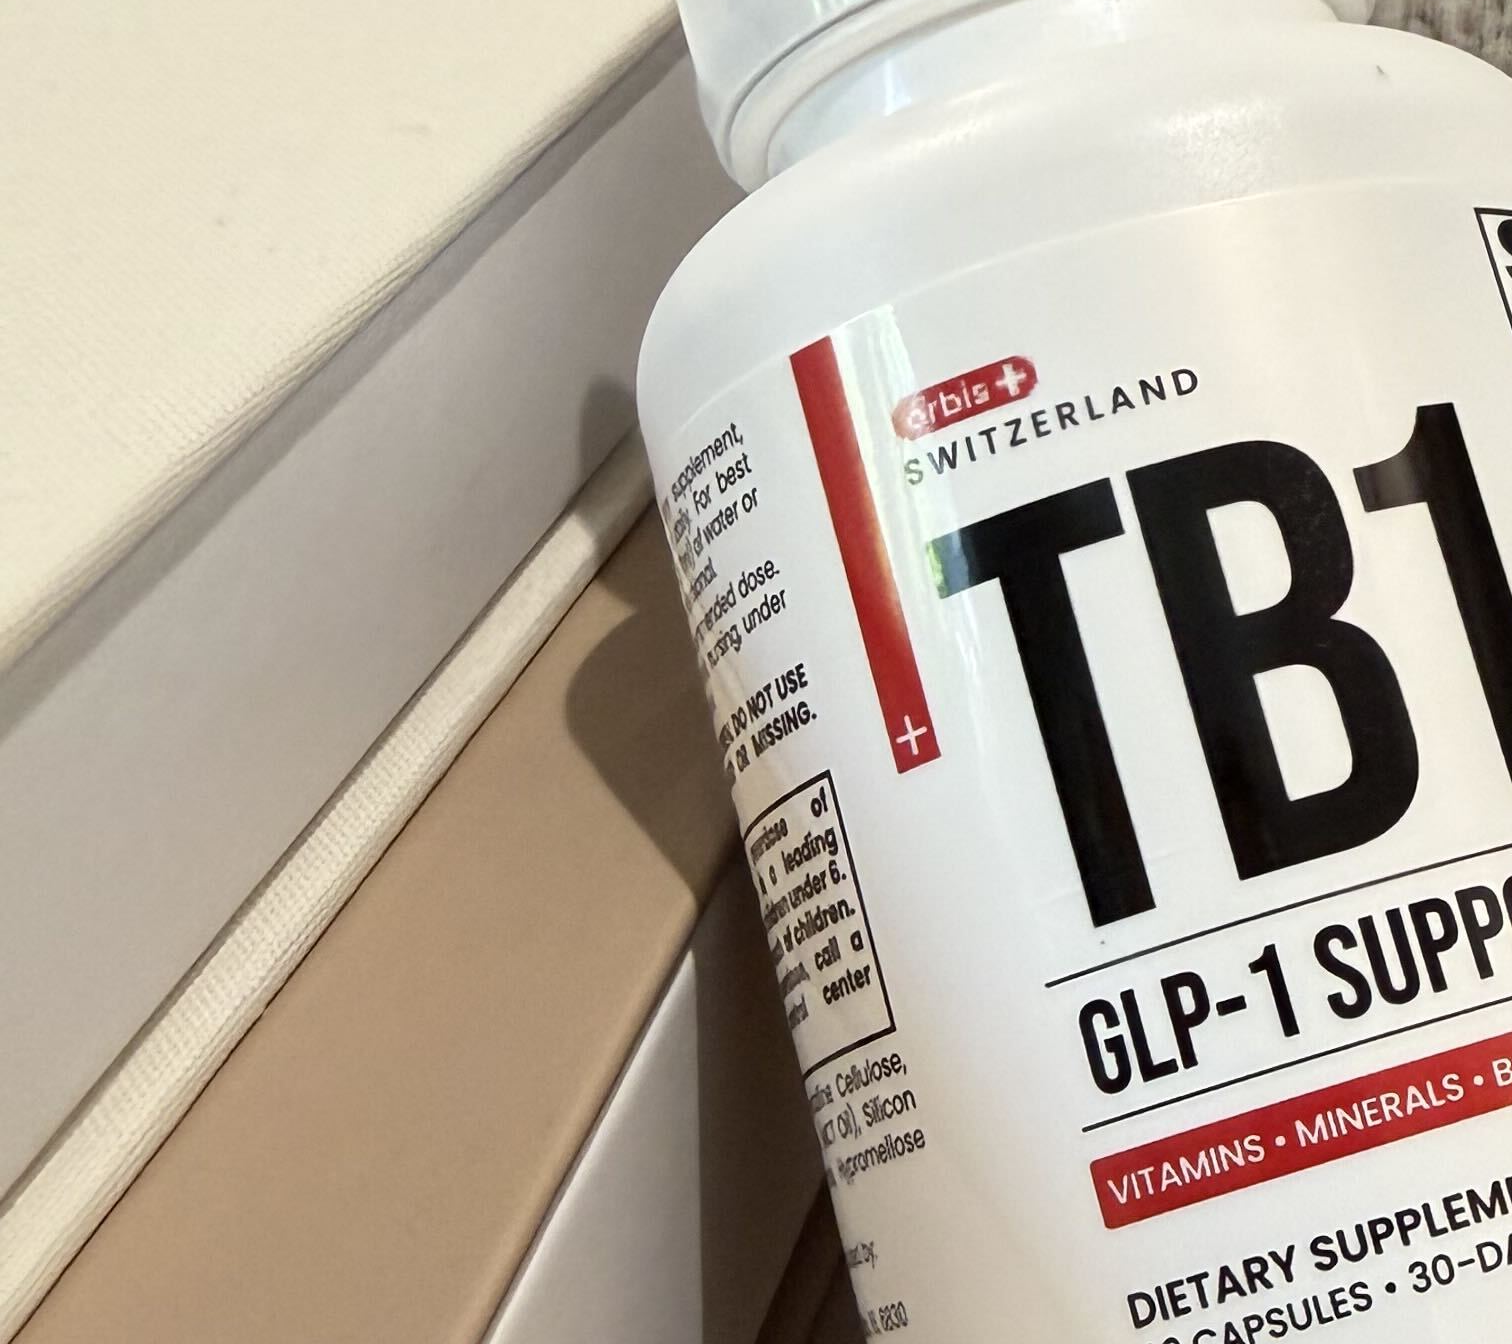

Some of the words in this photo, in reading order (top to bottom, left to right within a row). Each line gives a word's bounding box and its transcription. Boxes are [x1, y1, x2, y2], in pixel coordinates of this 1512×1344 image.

[903, 368, 1199, 486] SWITZERLAND
[716, 452, 752, 494] best
[702, 499, 739, 545] water
[741, 486, 759, 514] or
[737, 559, 781, 599] dose.
[742, 589, 787, 635] under
[745, 682, 774, 724] NOT
[774, 662, 808, 702] USE
[750, 700, 818, 758] MISSING.
[810, 785, 829, 819] of
[780, 826, 839, 876] leading
[787, 869, 828, 911] under
[828, 858, 848, 886] 6.
[793, 898, 857, 947] children.
[813, 935, 842, 973] call
[849, 929, 865, 953] a
[822, 963, 872, 1006] center
[1078, 943, 1300, 1096] GLP-1
[835, 1052, 908, 1098] Cellulose,
[1107, 1133, 1267, 1205] VITAMINS
[1294, 1073, 1465, 1148] MINERALS
[1127, 1244, 1297, 1331] DIETARY
